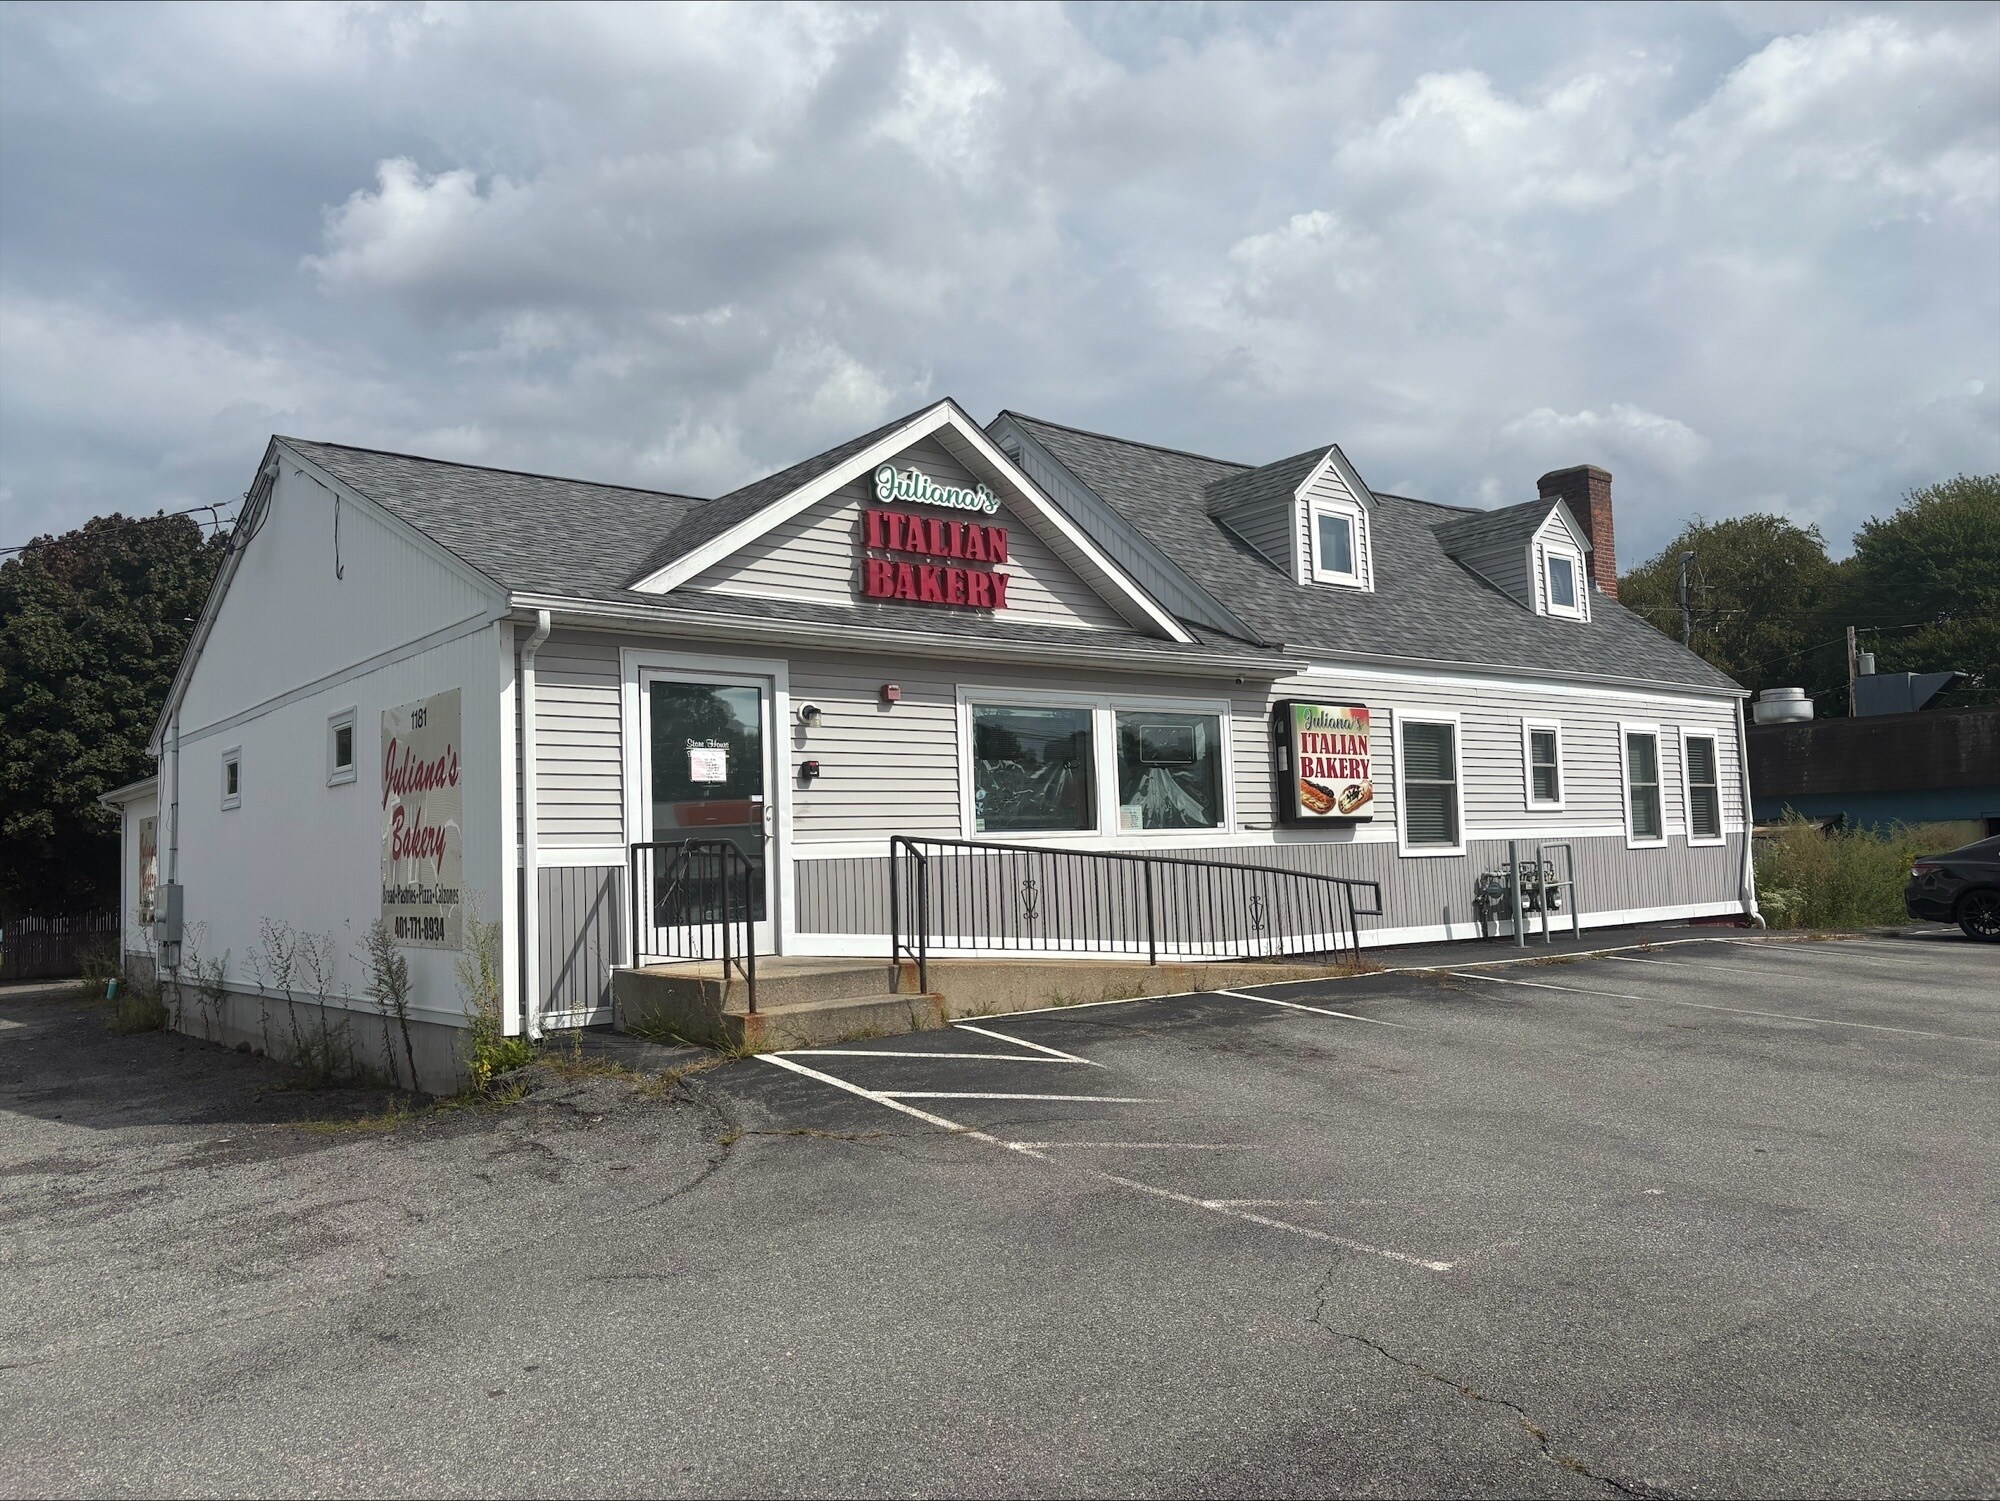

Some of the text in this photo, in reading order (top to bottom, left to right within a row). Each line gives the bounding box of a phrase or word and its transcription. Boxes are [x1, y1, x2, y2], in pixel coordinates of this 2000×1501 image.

[875, 464, 1001, 514] Juliana's
[864, 509, 1008, 563] ITALIAN
[864, 558, 1010, 609] BAKERY
[411, 708, 427, 729] 1181
[1303, 708, 1364, 731] Juliana's
[1300, 732, 1368, 756] ITALIAN
[383, 737, 459, 811] Juliana's
[1300, 756, 1370, 779] BAKERY
[392, 805, 446, 876] Bakery
[395, 916, 445, 941] 401-771-8934
